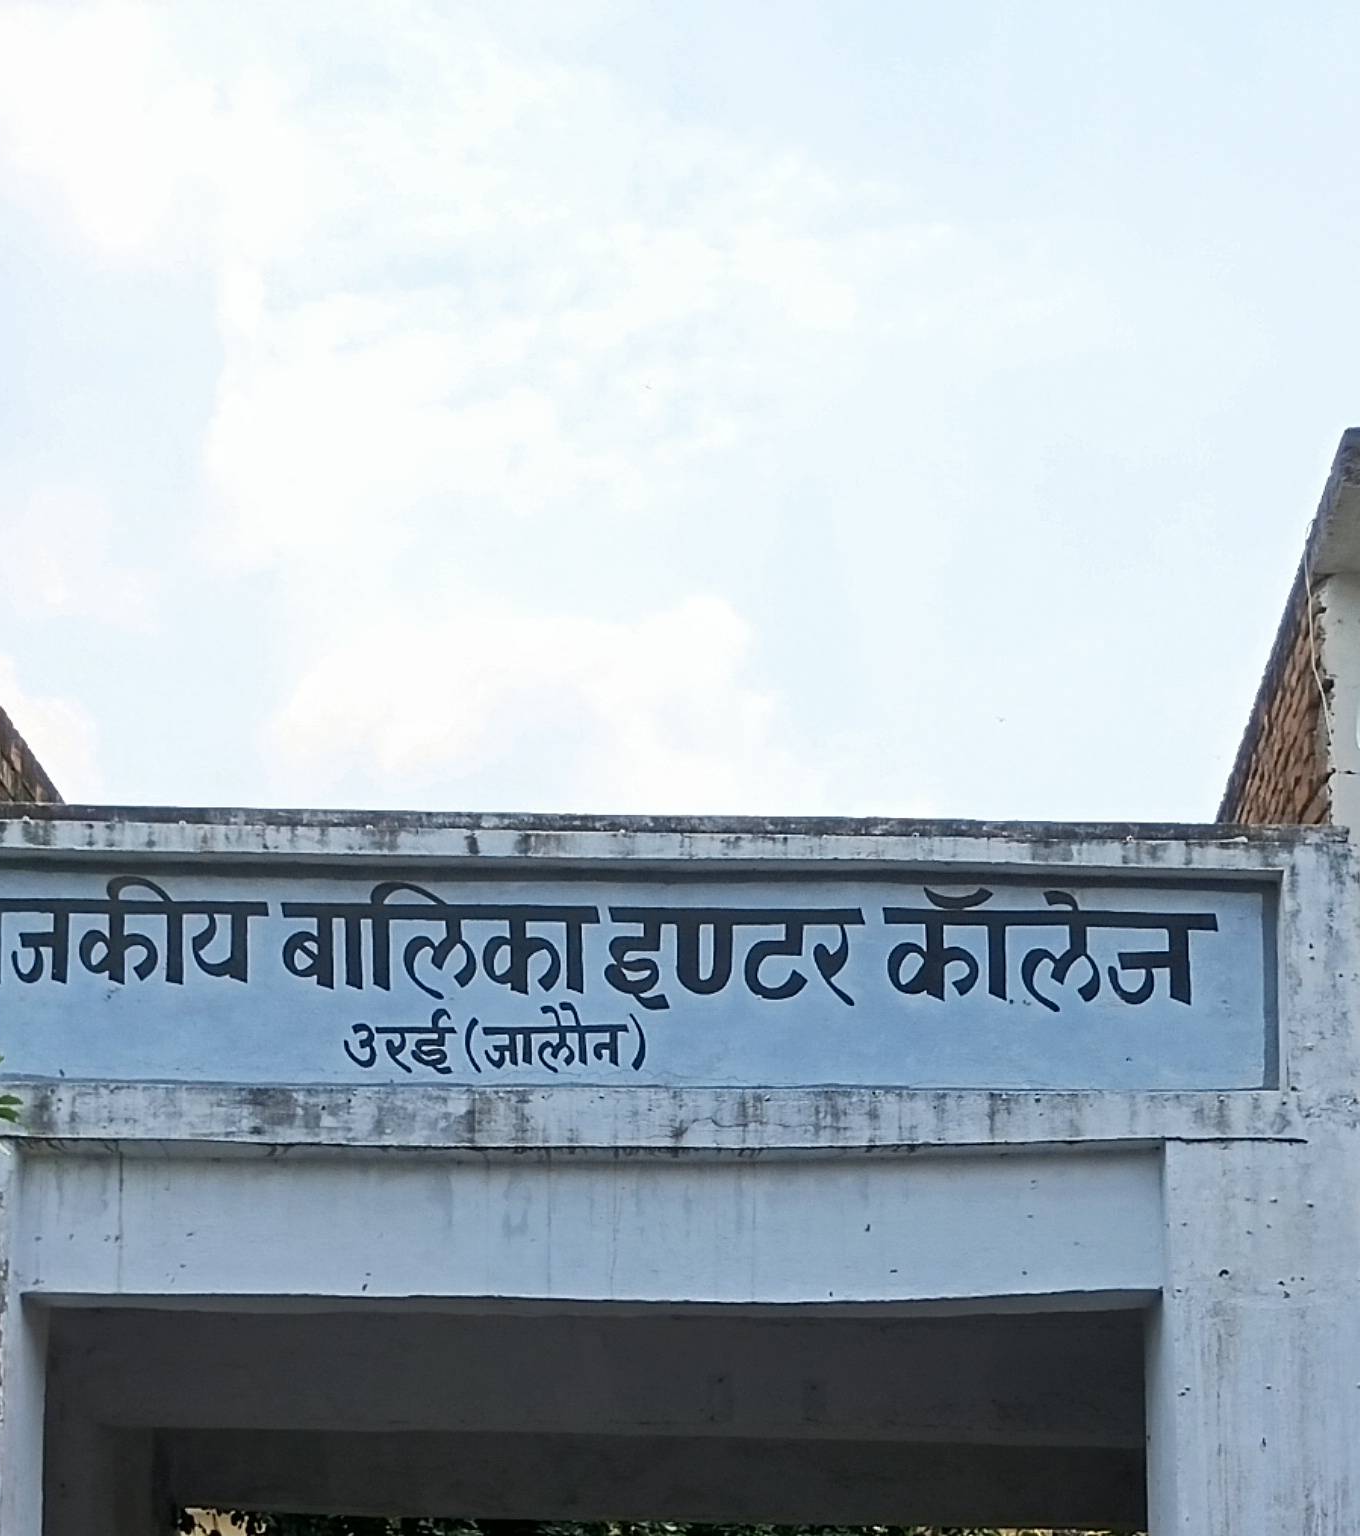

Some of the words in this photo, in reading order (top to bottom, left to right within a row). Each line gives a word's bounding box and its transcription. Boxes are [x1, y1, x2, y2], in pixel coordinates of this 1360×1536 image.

[281, 881, 600, 1000] बालिका
[606, 904, 864, 1010] इण्टर
[883, 886, 1217, 1012] कॉलेज
[343, 1008, 456, 1074] उरई
